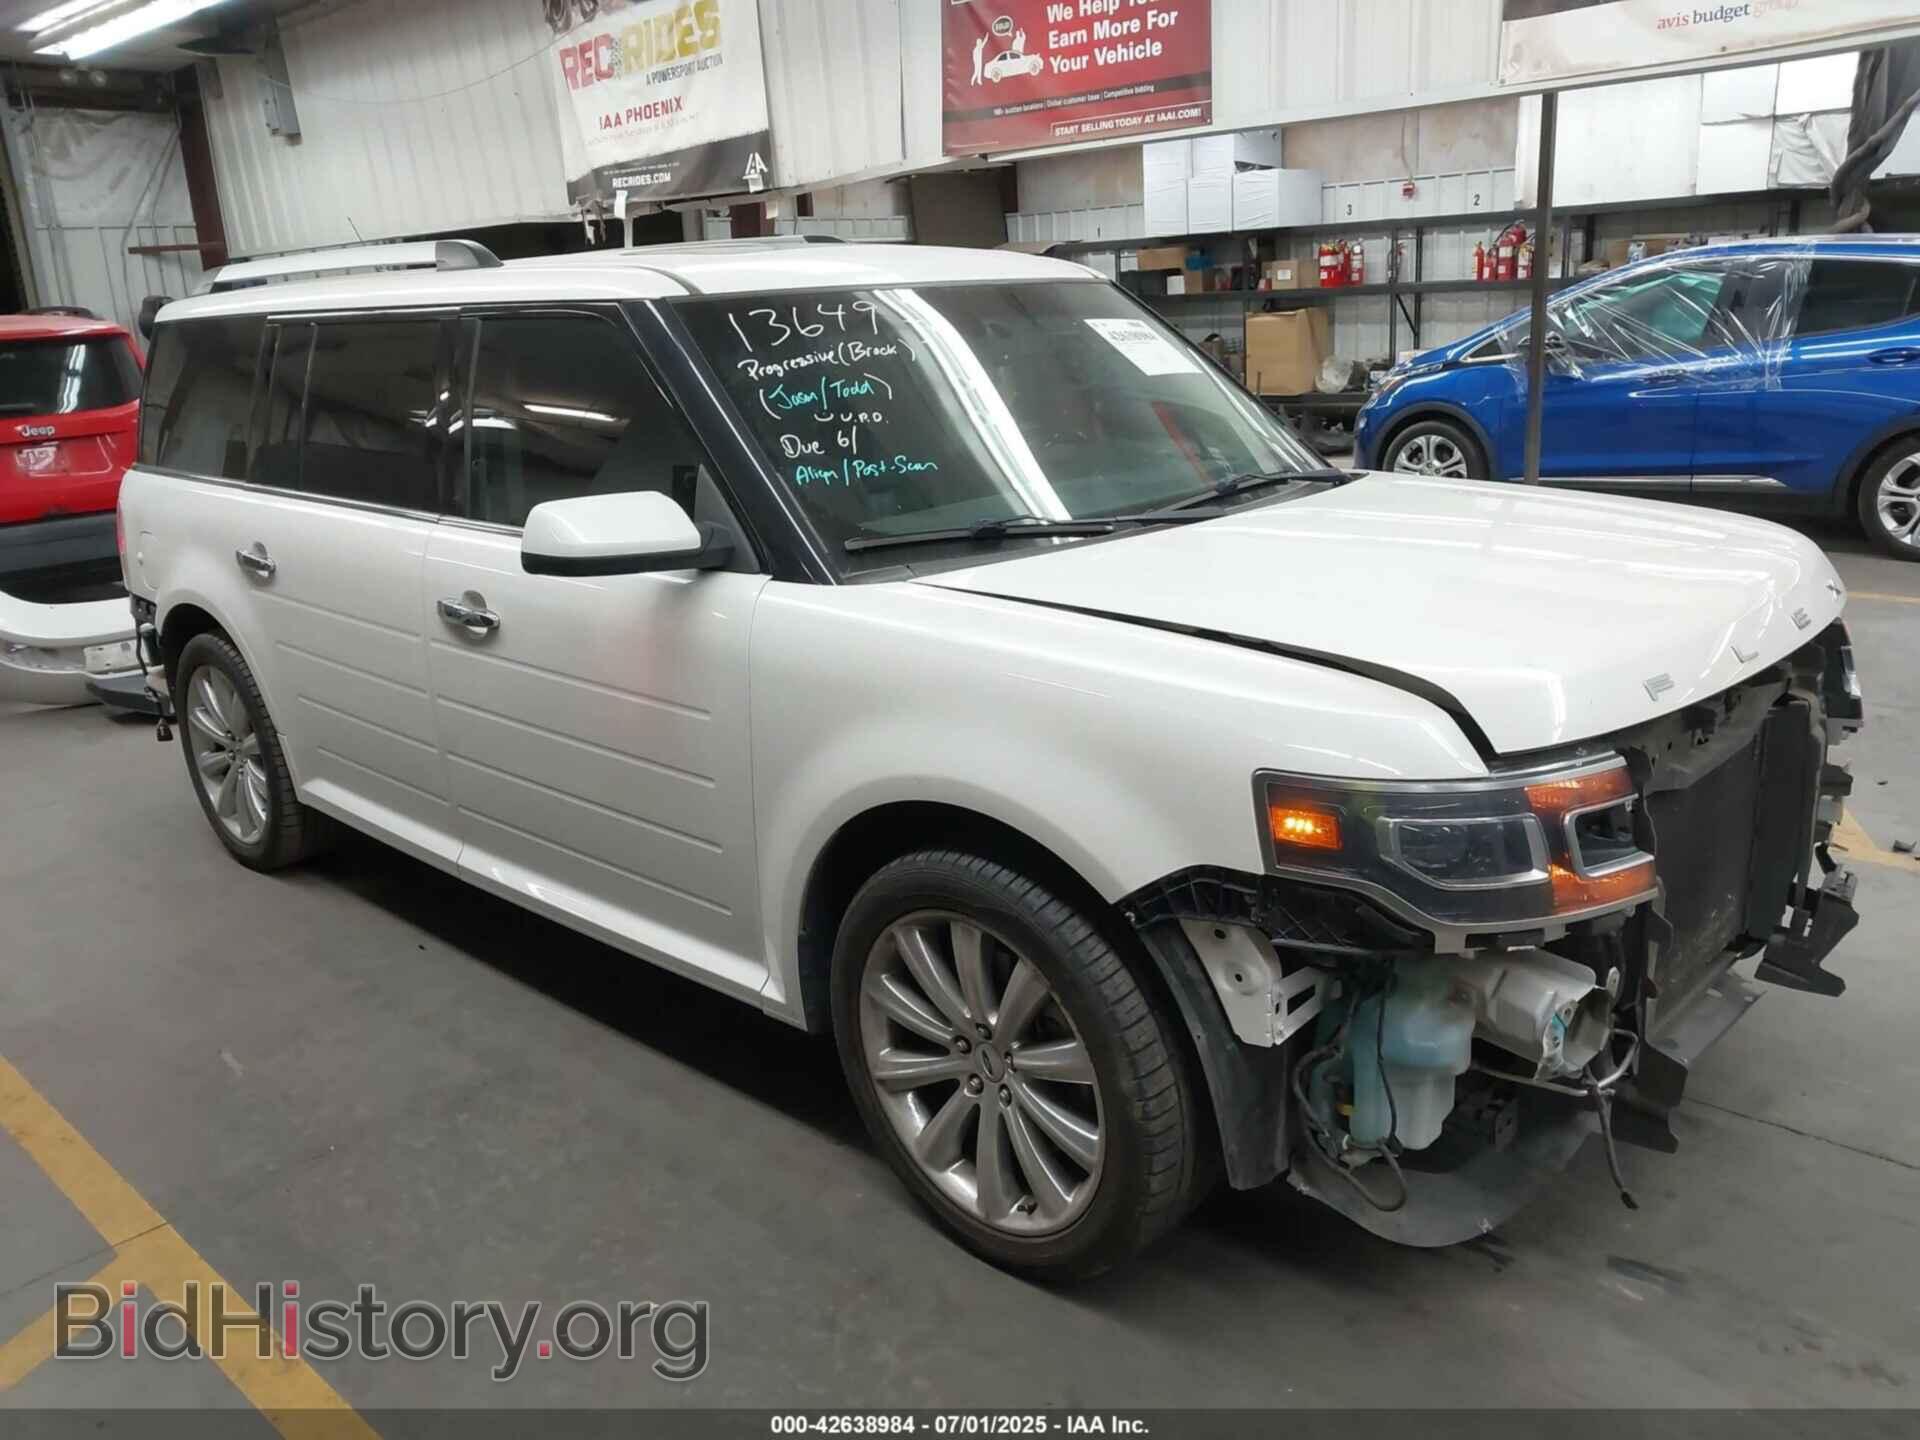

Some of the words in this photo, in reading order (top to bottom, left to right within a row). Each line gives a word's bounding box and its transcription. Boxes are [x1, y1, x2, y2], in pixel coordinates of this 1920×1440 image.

[1046, 3, 1073, 24] We
[1079, 0, 1120, 17] Help
[1656, 12, 1690, 30] avis
[1692, 3, 1751, 24] budget
[1049, 29, 1088, 50] Earn
[1093, 18, 1140, 41] More
[1146, 9, 1179, 32] For
[1050, 53, 1089, 75] Your
[1093, 38, 1163, 67] Vehicle
[651, 59, 697, 85] POWERSPORT
[626, 95, 683, 124] PHOENIX
[1054, 124, 1079, 137] START
[1081, 120, 1114, 133] SELLING
[1115, 116, 1142, 128] TODAY
[1144, 113, 1156, 124] AT
[612, 172, 672, 188] RECRIDES.COM
[1346, 204, 1353, 216] 3
[1473, 193, 1481, 206] 2
[728, 300, 880, 353] 13649
[22, 425, 56, 439] Jeep
[780, 434, 825, 459] Due
